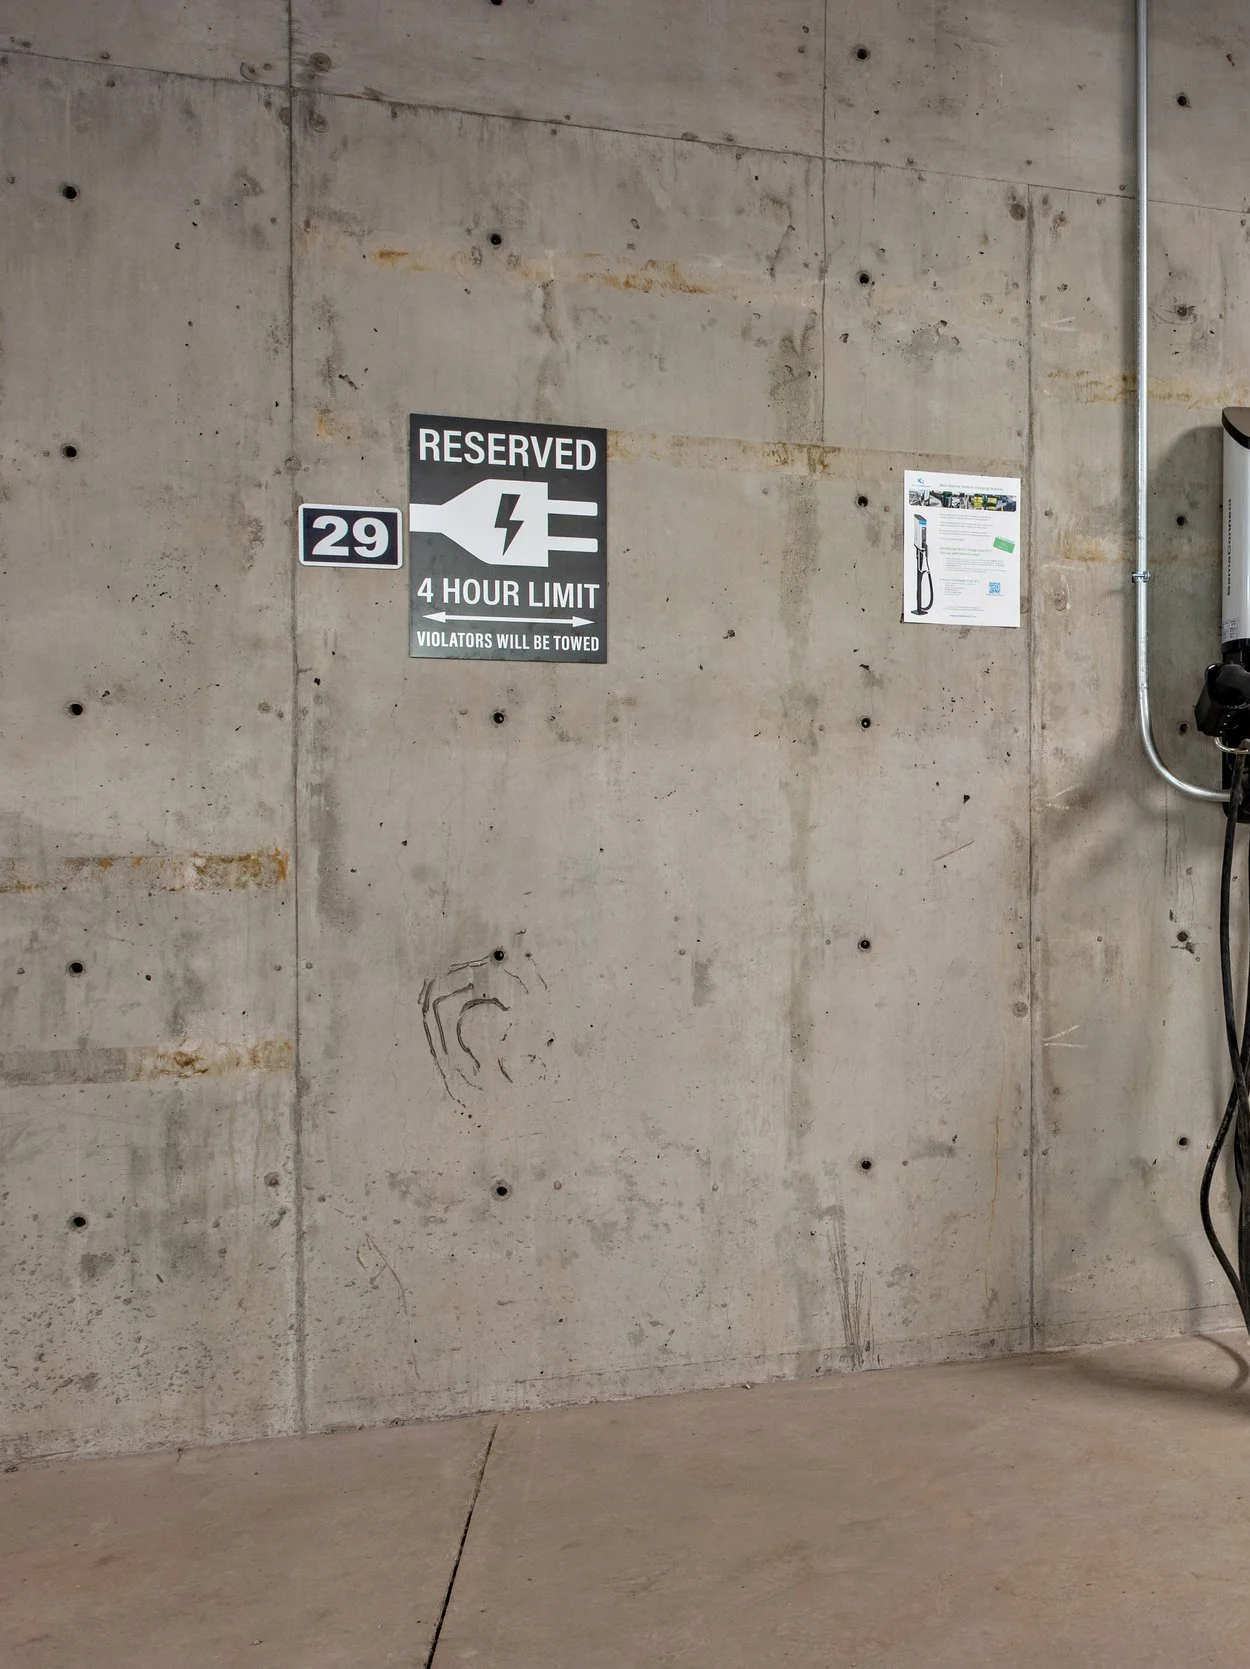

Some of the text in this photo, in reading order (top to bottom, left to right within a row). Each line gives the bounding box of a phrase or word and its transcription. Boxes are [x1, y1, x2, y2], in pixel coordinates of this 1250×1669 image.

[419, 428, 597, 471] RESERVED
[312, 515, 389, 558] 29
[417, 577, 600, 609] 4 HOUR LIMIT
[417, 631, 599, 651] VIOLATORS WILL BE TOWED
